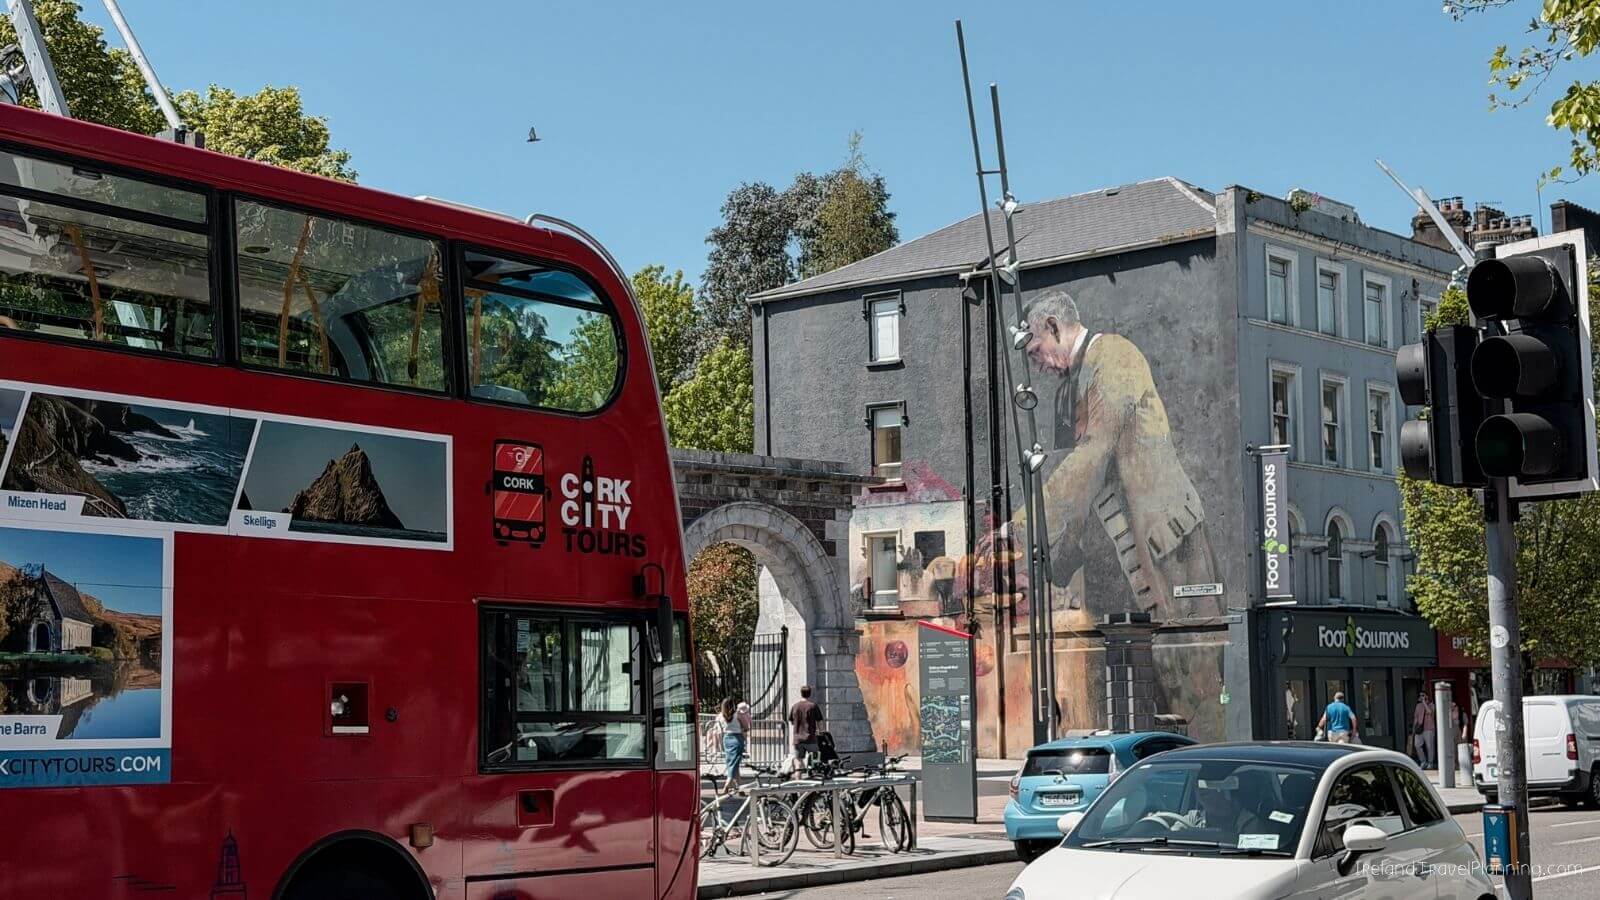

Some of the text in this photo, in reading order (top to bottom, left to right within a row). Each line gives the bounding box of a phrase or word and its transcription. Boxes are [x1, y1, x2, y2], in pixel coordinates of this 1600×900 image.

[503, 476, 534, 490] CORK
[8, 496, 66, 511] Mizen Head
[244, 515, 277, 529] Skelligs
[560, 500, 632, 531] CITY
[1264, 463, 1280, 589] FOOT SOLUTIONS
[562, 528, 647, 557] TOURS
[1318, 625, 1410, 649] FOOT SOLUTIONS
[14, 722, 47, 735] Barra
